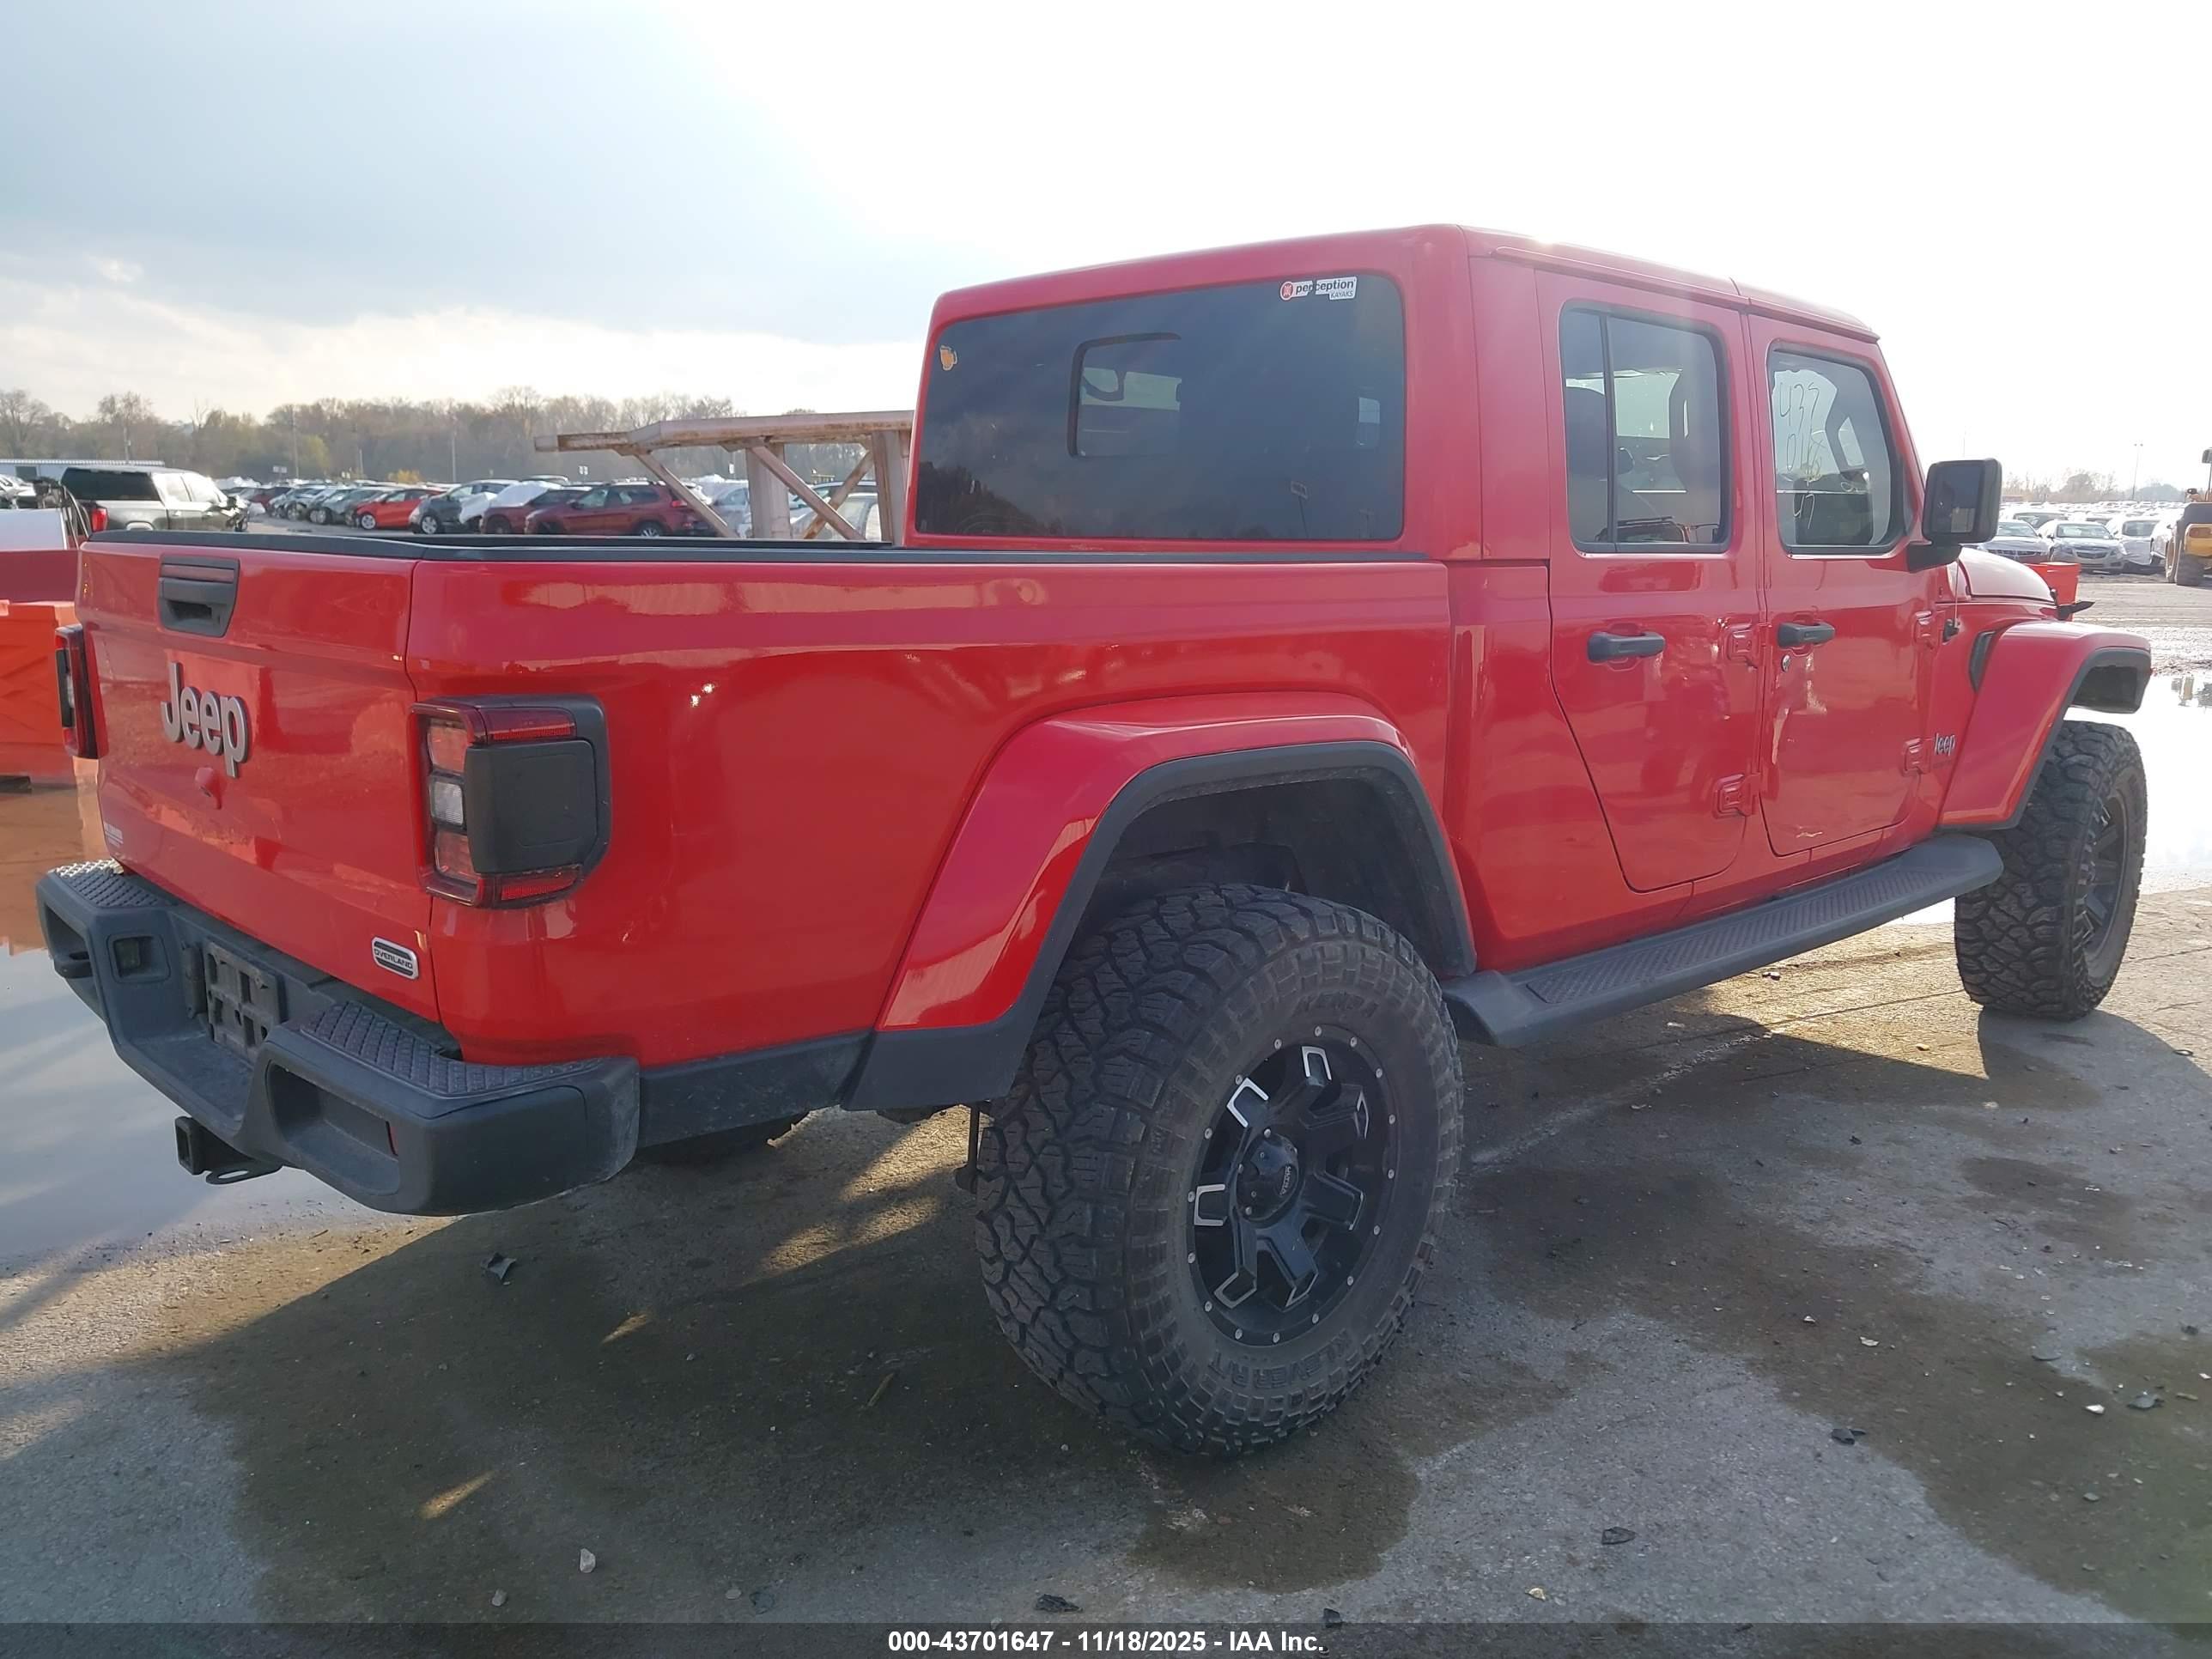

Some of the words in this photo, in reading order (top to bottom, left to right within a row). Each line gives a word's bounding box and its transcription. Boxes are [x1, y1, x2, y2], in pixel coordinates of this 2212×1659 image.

[1296, 279, 1354, 295] perception
[1330, 289, 1353, 299] KAYAKS
[161, 661, 250, 778] Jeep
[374, 948, 414, 969] OVERLAND
